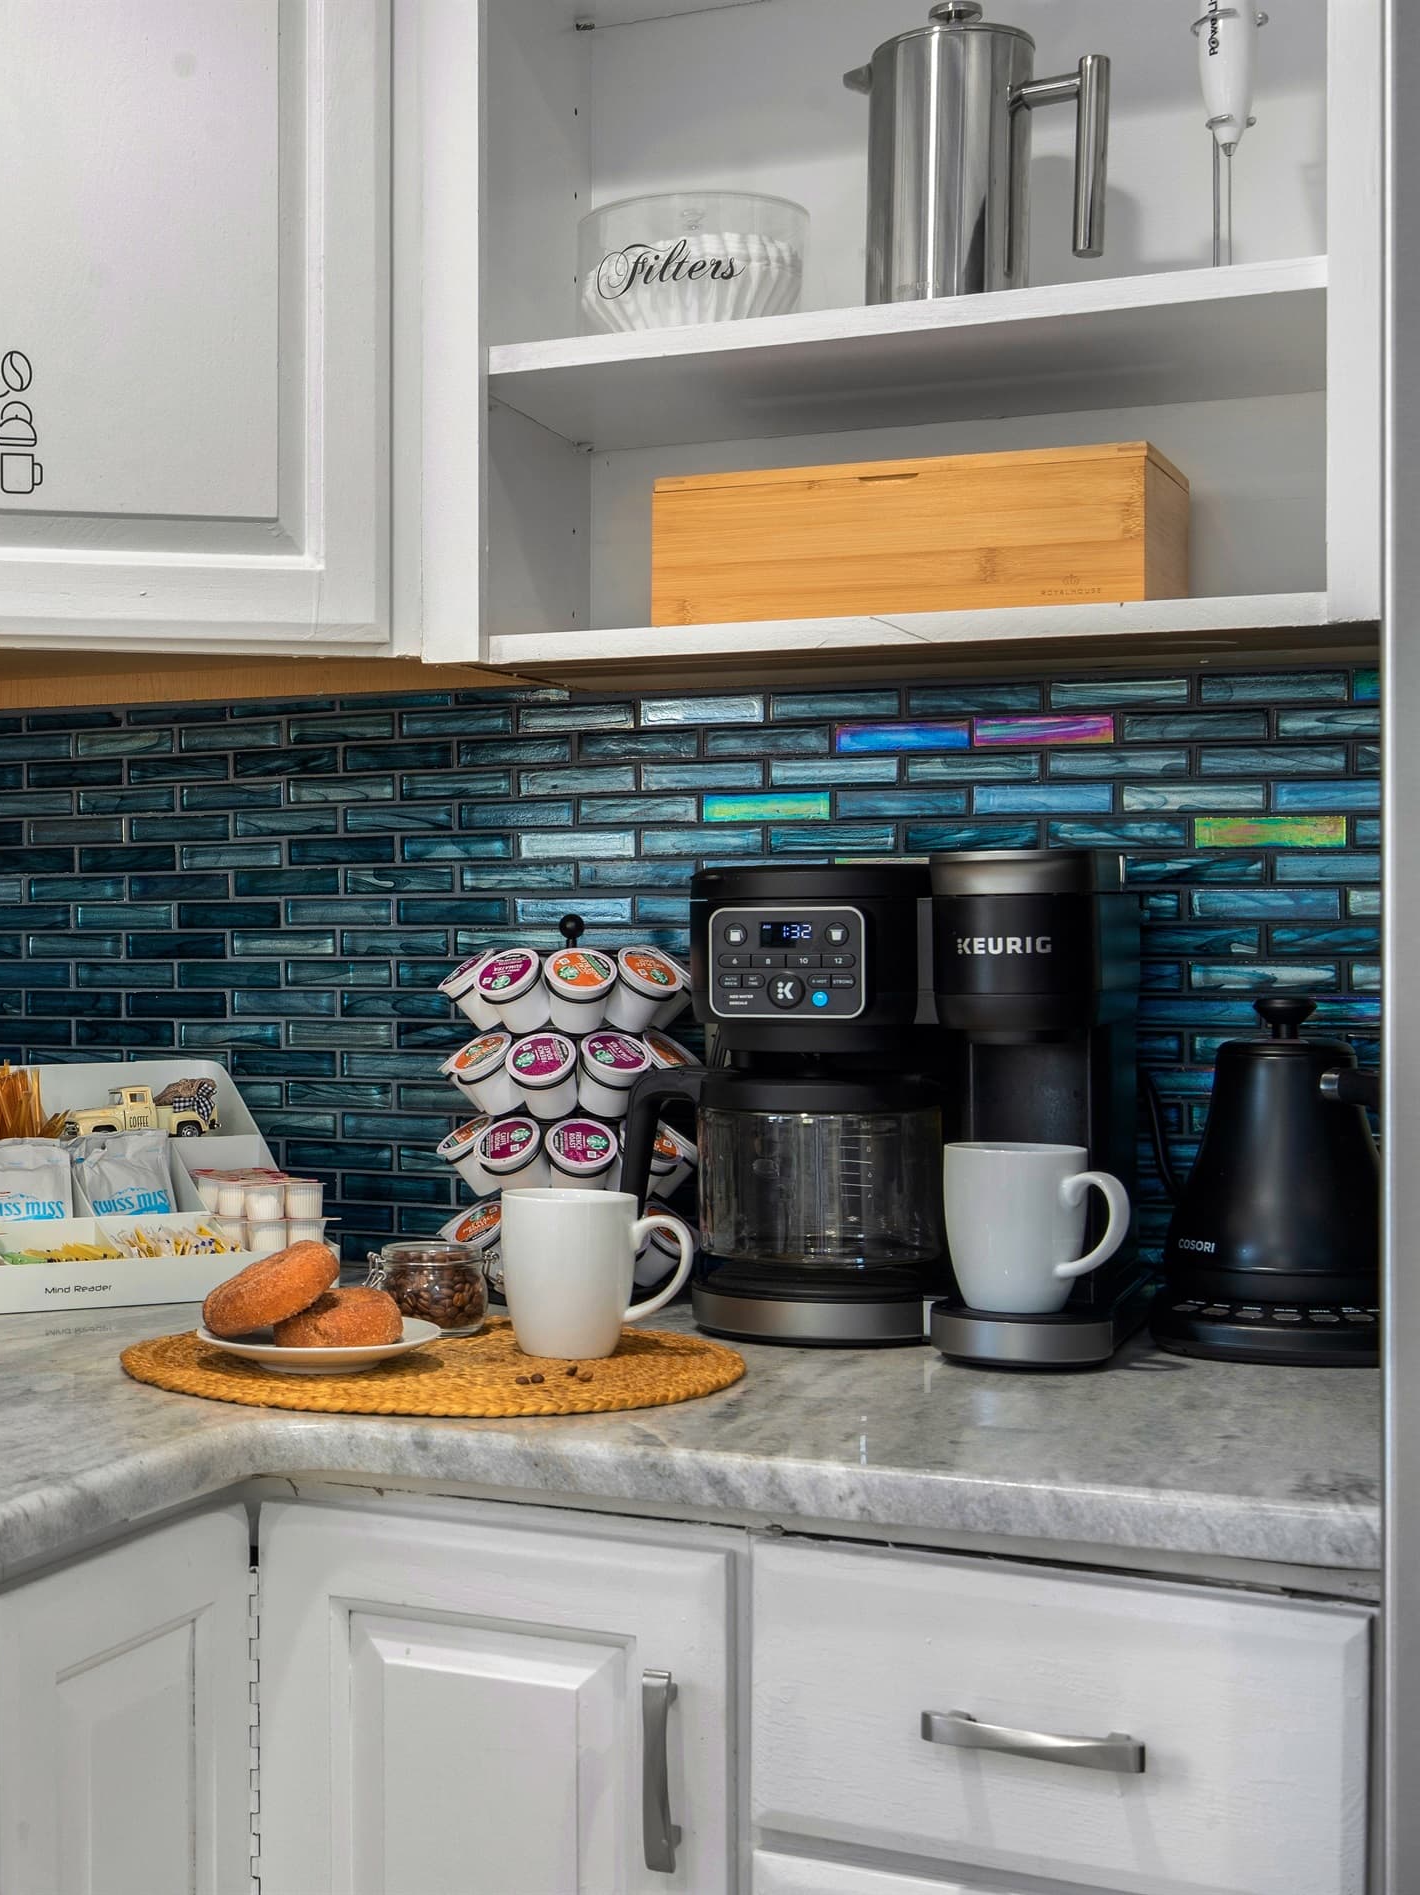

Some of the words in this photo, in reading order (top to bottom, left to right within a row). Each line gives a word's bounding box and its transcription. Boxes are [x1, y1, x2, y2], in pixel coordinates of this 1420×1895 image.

[597, 239, 746, 300] Filters
[1041, 587, 1101, 596] ROYALHOUSE
[782, 924, 812, 939] 1:32
[956, 936, 1052, 955] KEURIG
[129, 1115, 149, 1129] COFFEE
[1178, 1238, 1216, 1253] COSORI
[44, 1285, 71, 1294] Mind
[74, 1284, 113, 1293] Reader
